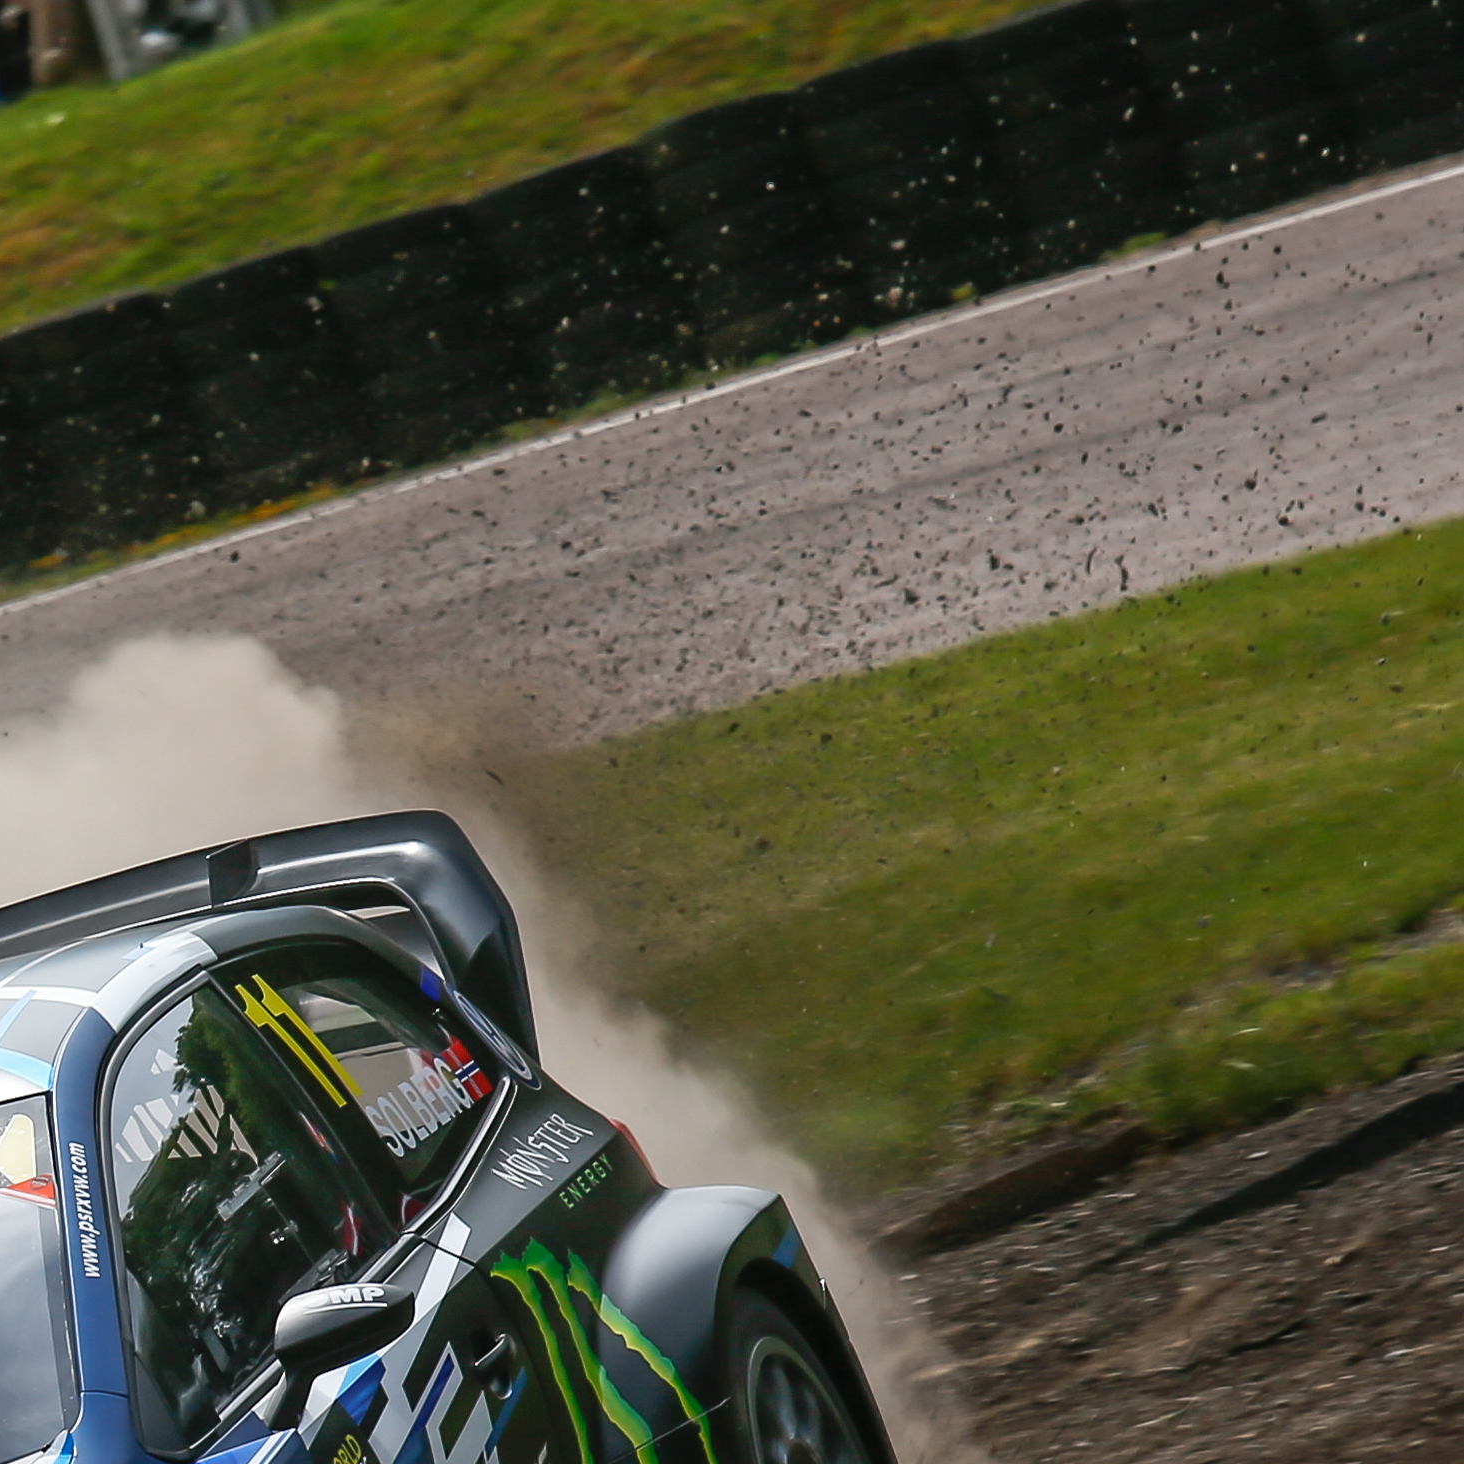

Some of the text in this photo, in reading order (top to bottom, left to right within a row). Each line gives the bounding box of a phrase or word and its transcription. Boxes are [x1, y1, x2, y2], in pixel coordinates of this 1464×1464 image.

[365, 1055, 477, 1158] SOLBERG
[491, 1112, 595, 1191] MONSTER
[68, 1140, 103, 1279] www.psrxvw.com
[558, 1153, 613, 1210] ENERGY
